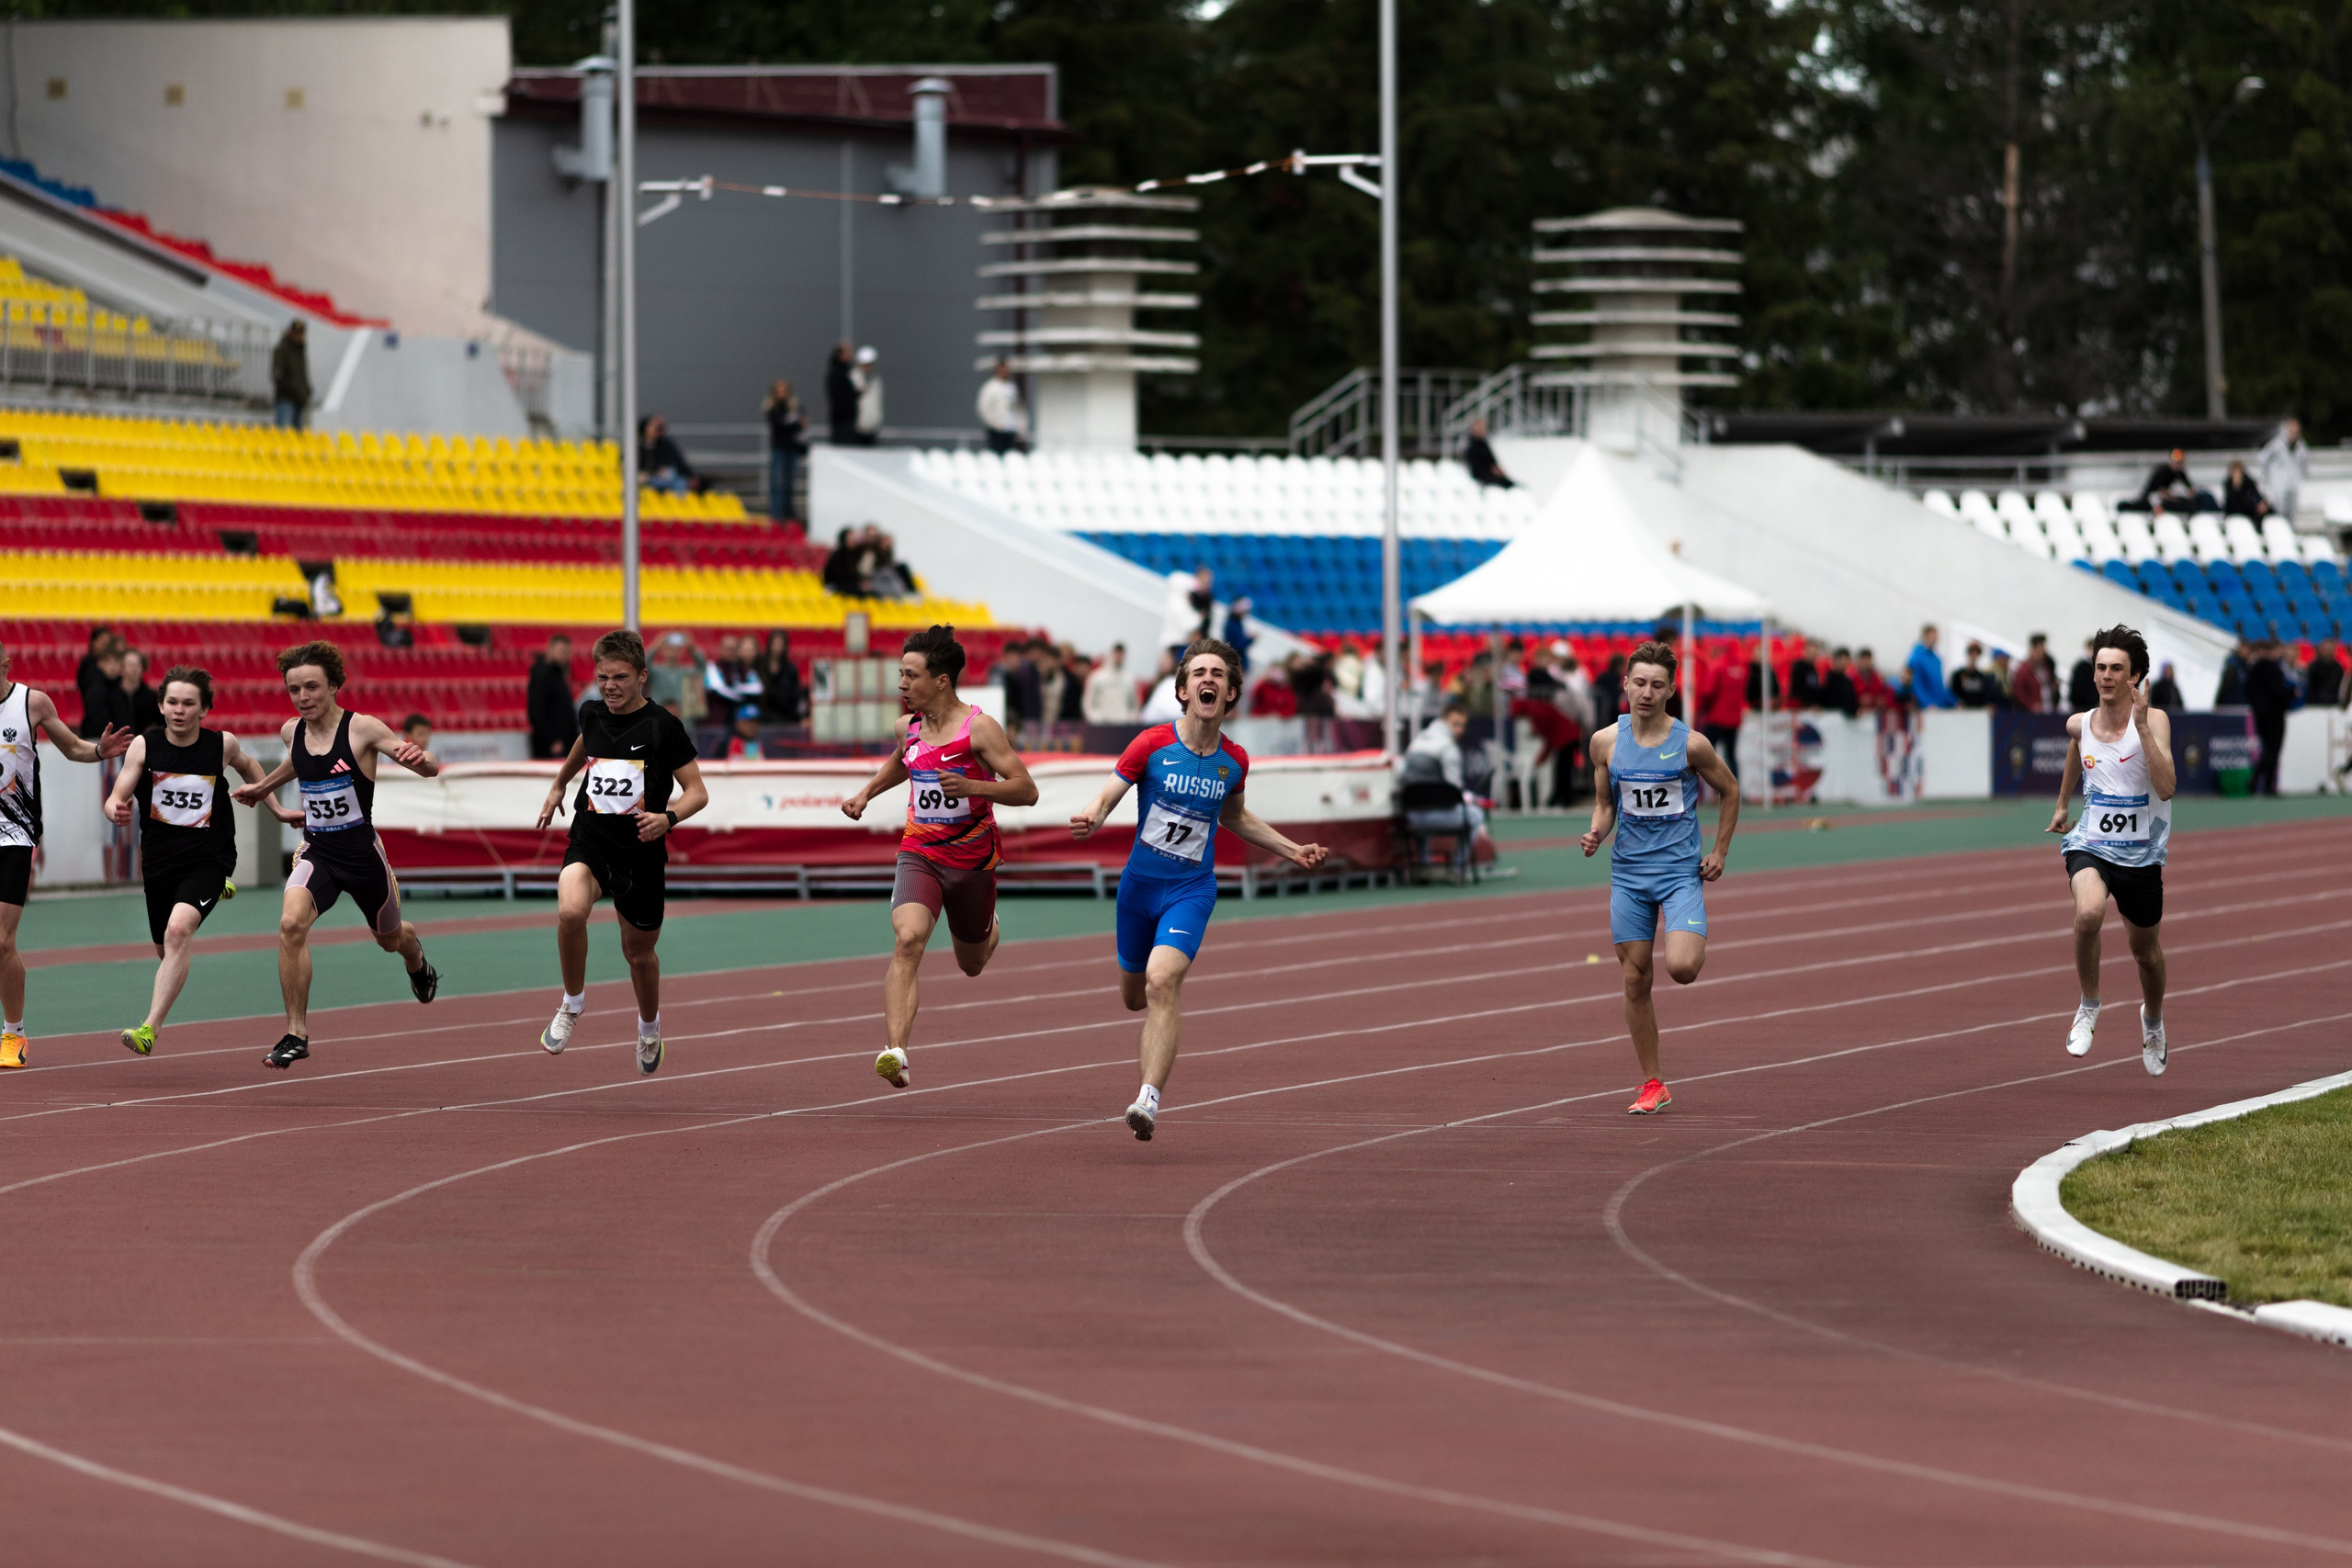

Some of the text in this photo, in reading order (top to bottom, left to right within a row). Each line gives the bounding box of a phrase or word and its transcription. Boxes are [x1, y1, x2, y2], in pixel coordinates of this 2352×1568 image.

[592, 776, 634, 797] 322
[1163, 773, 1226, 800] RUSSIA
[1632, 787, 1668, 807] 112
[161, 789, 204, 810] 335
[309, 796, 349, 819] 535
[1165, 821, 1193, 845] 17
[2099, 813, 2137, 833] 691
[1159, 851, 1177, 861] ВФЛА
